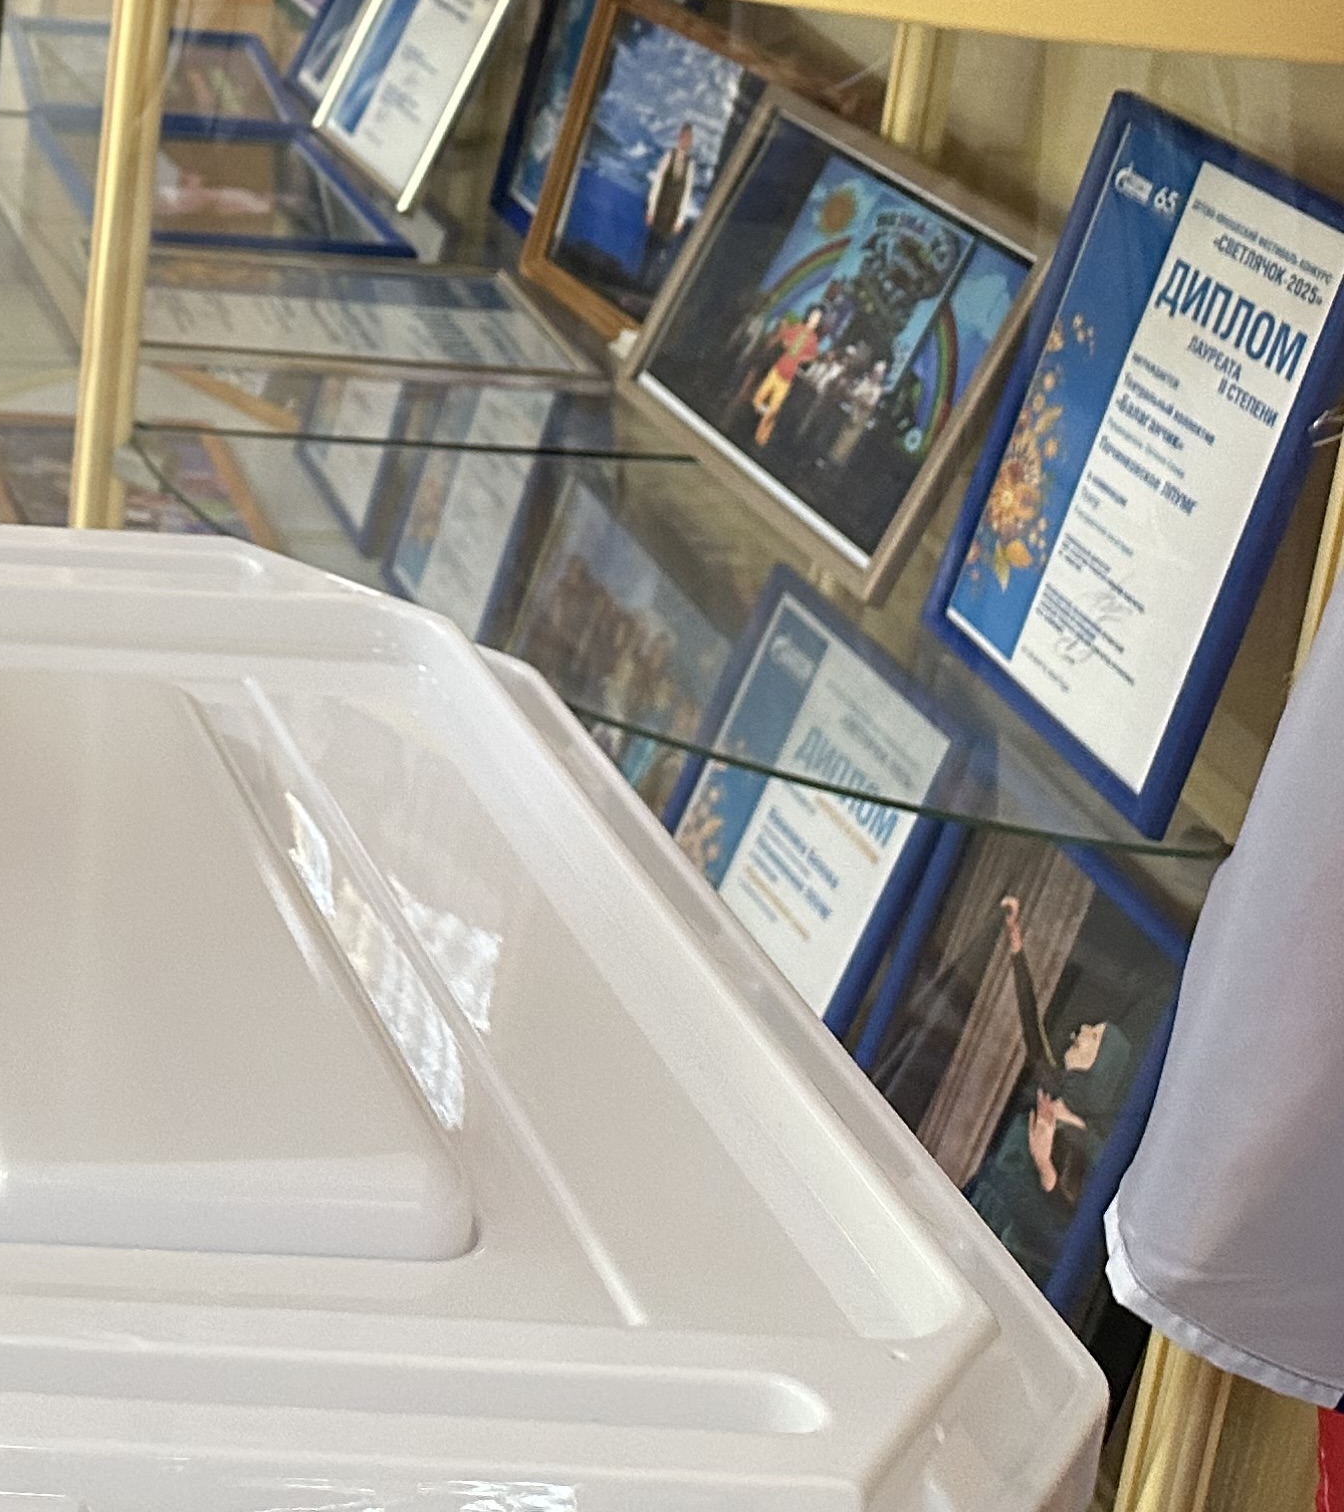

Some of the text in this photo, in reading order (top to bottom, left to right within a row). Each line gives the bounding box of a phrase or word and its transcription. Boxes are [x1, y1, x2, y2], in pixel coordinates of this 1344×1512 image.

[1153, 187, 1179, 215] 65
[1154, 256, 1309, 384] ДИПЛОМ
[1186, 335, 1243, 383] ЛАУРЕАТА
[1226, 383, 1280, 430] СТЕПЕНИ
